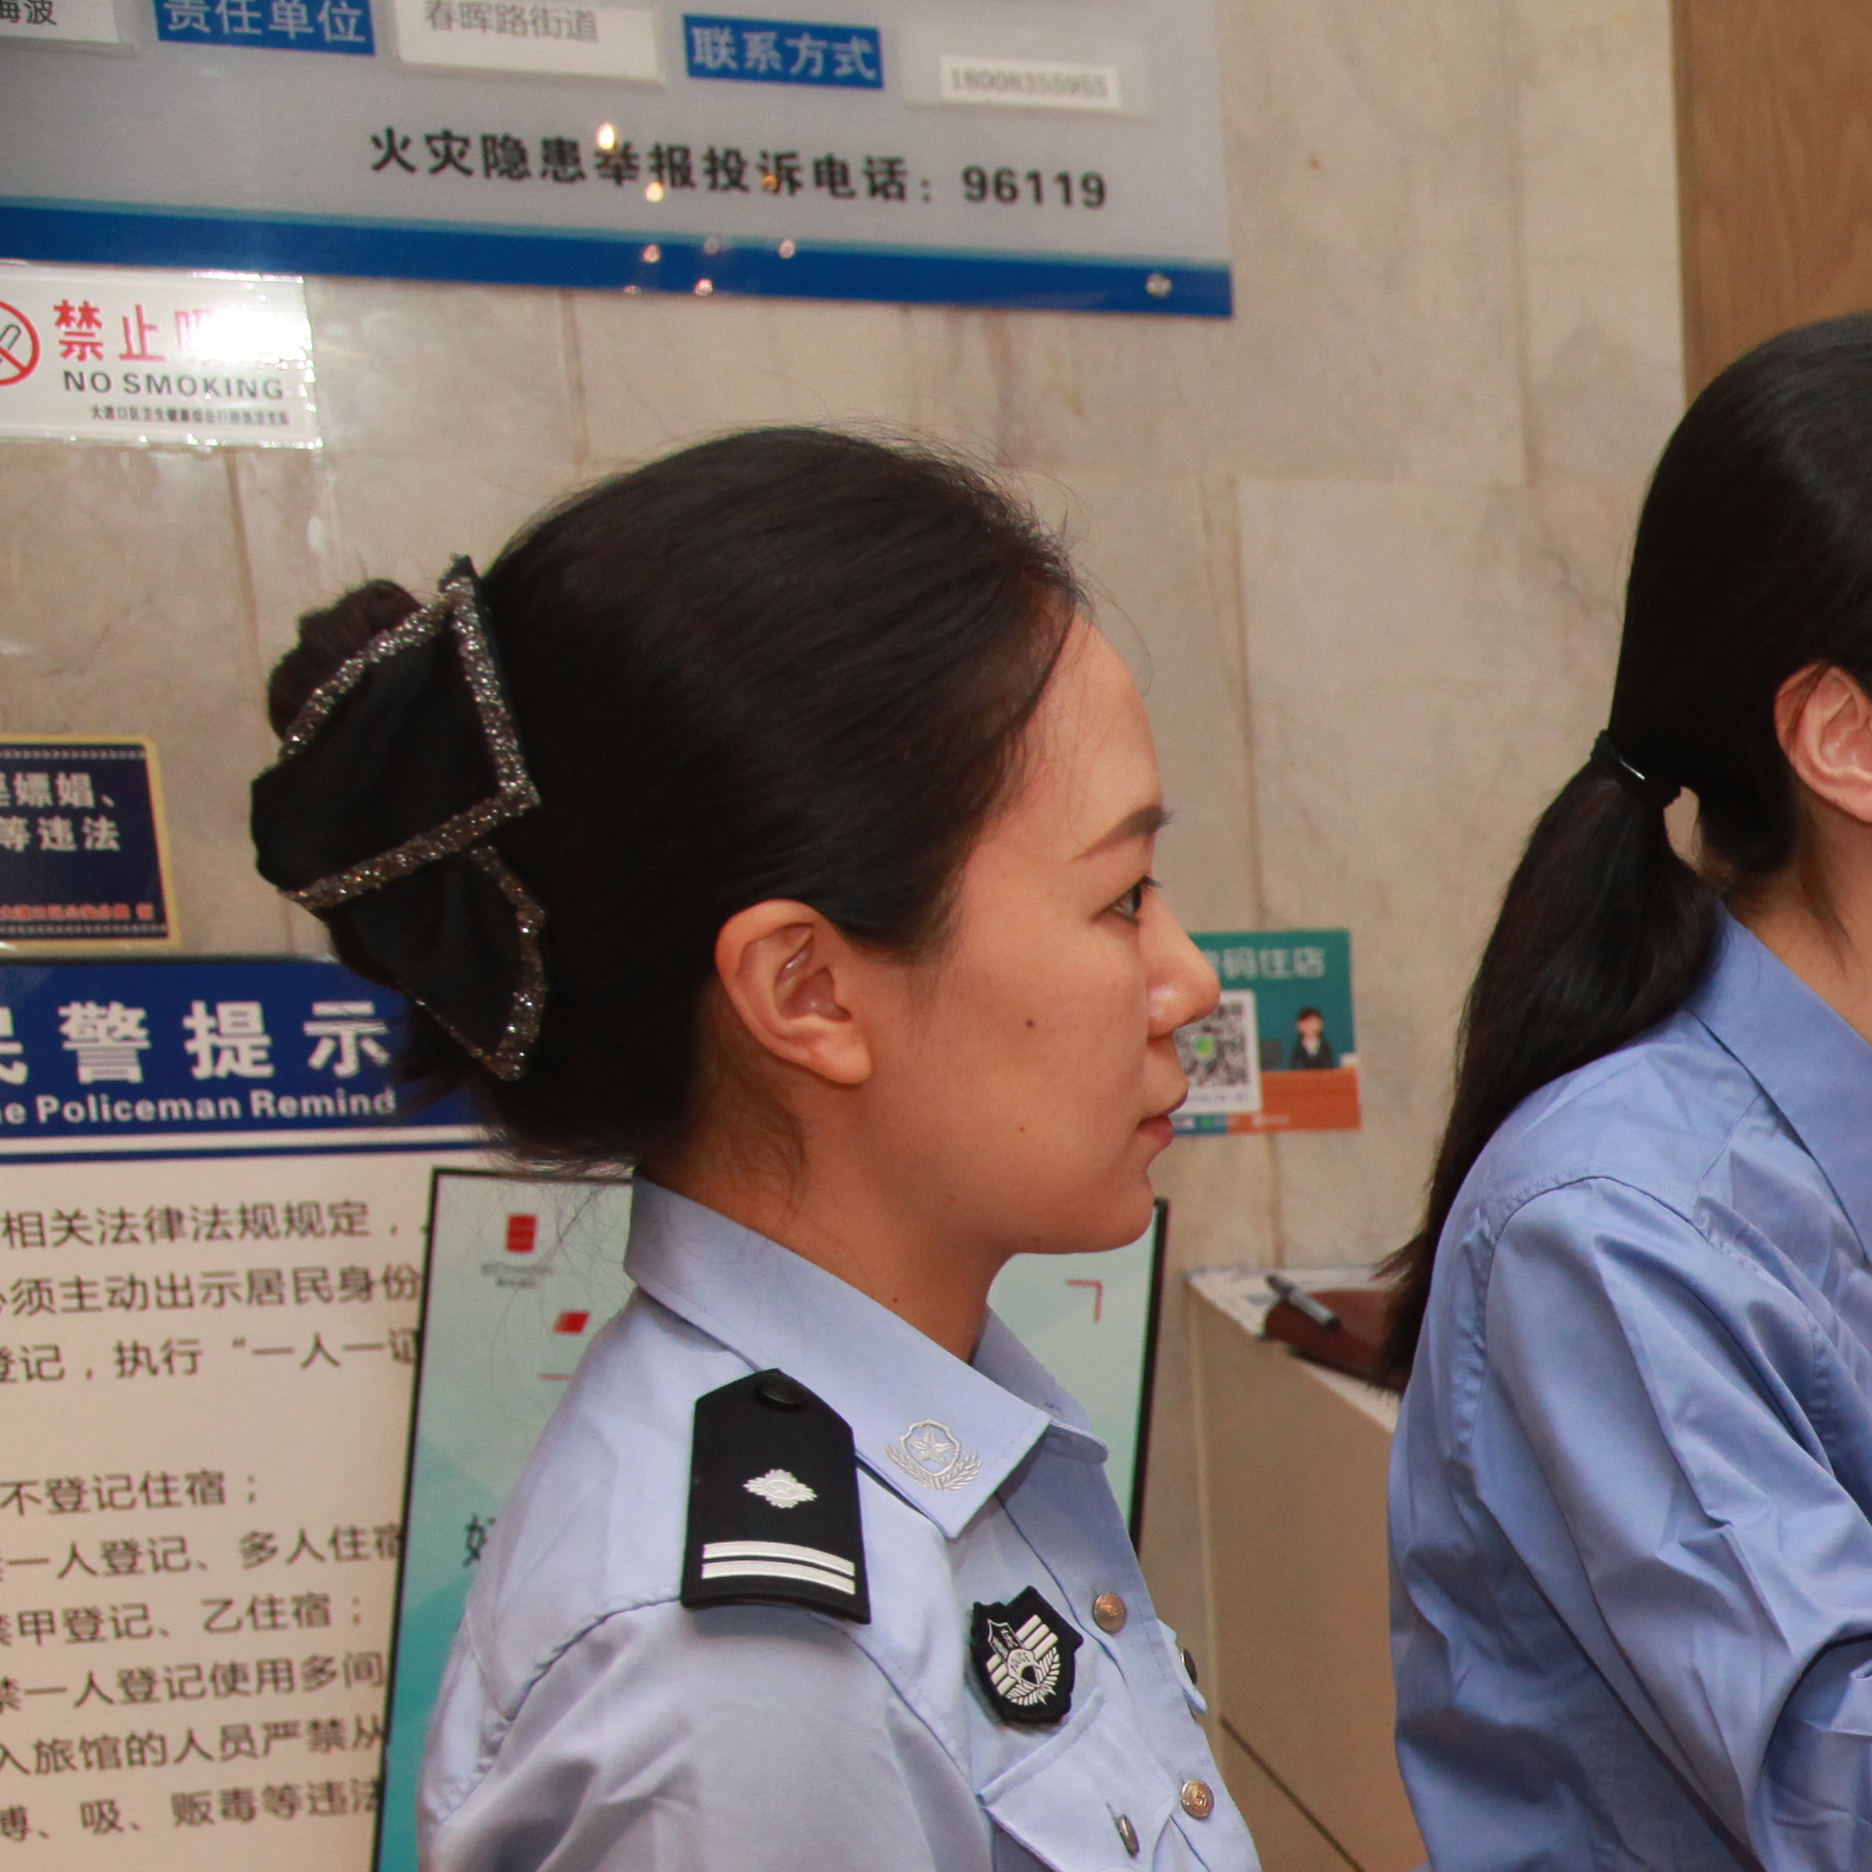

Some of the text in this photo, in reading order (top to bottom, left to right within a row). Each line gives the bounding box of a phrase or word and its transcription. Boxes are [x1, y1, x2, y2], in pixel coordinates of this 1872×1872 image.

[163, 0, 366, 43] 责任单位
[690, 26, 877, 80] 联系方式
[63, 370, 284, 400] NO SMOKING
[0, 815, 121, 852] 等违法
[0, 1087, 397, 1125] e Policeman Remind
[0, 1198, 430, 1249] 相关法律法规规定，
[0, 1263, 424, 1317] 须主动出示居民身份
[0, 1523, 401, 1583] 一人登记、多人住宿
[0, 1591, 361, 1648] 甲登记、乙住宿；
